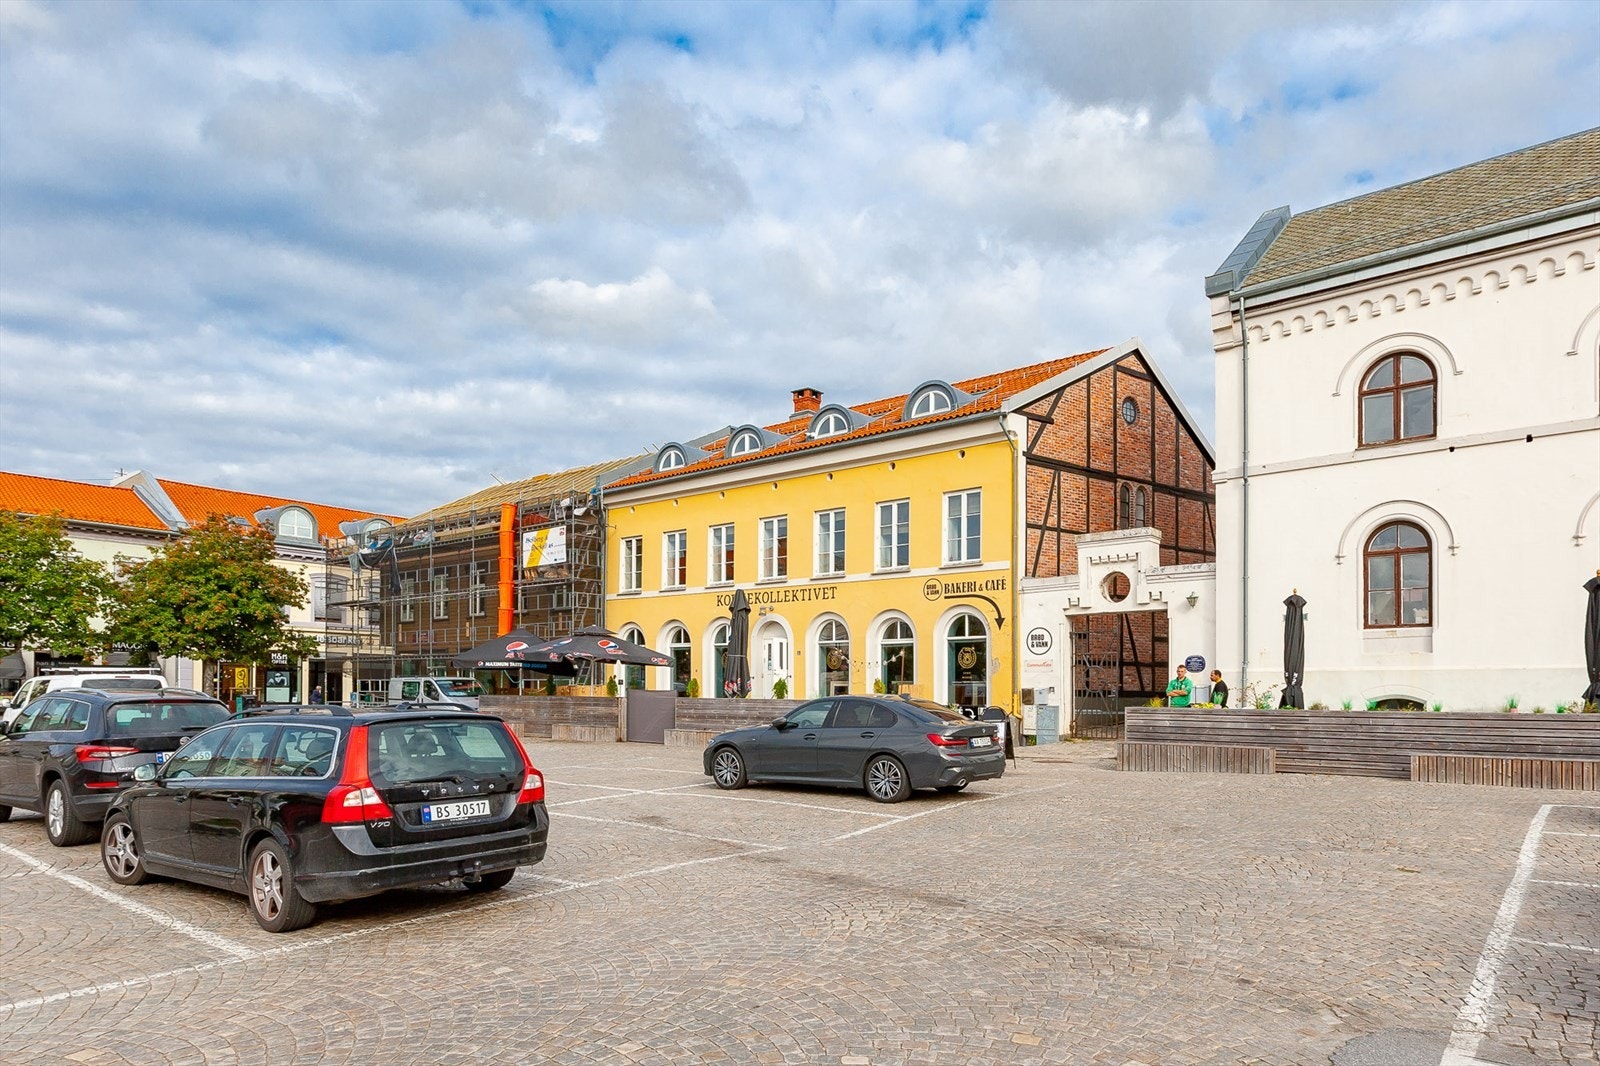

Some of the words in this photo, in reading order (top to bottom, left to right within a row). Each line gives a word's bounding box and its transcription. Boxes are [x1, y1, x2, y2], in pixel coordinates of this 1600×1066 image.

[944, 581, 976, 594] BAKERI
[978, 584, 984, 592] &
[985, 576, 1006, 591] CAFÉ
[716, 586, 838, 607] KOEKOLLEKTIVET
[421, 784, 495, 796] VOLVO
[436, 805, 450, 819] BS
[455, 802, 486, 817] 30517
